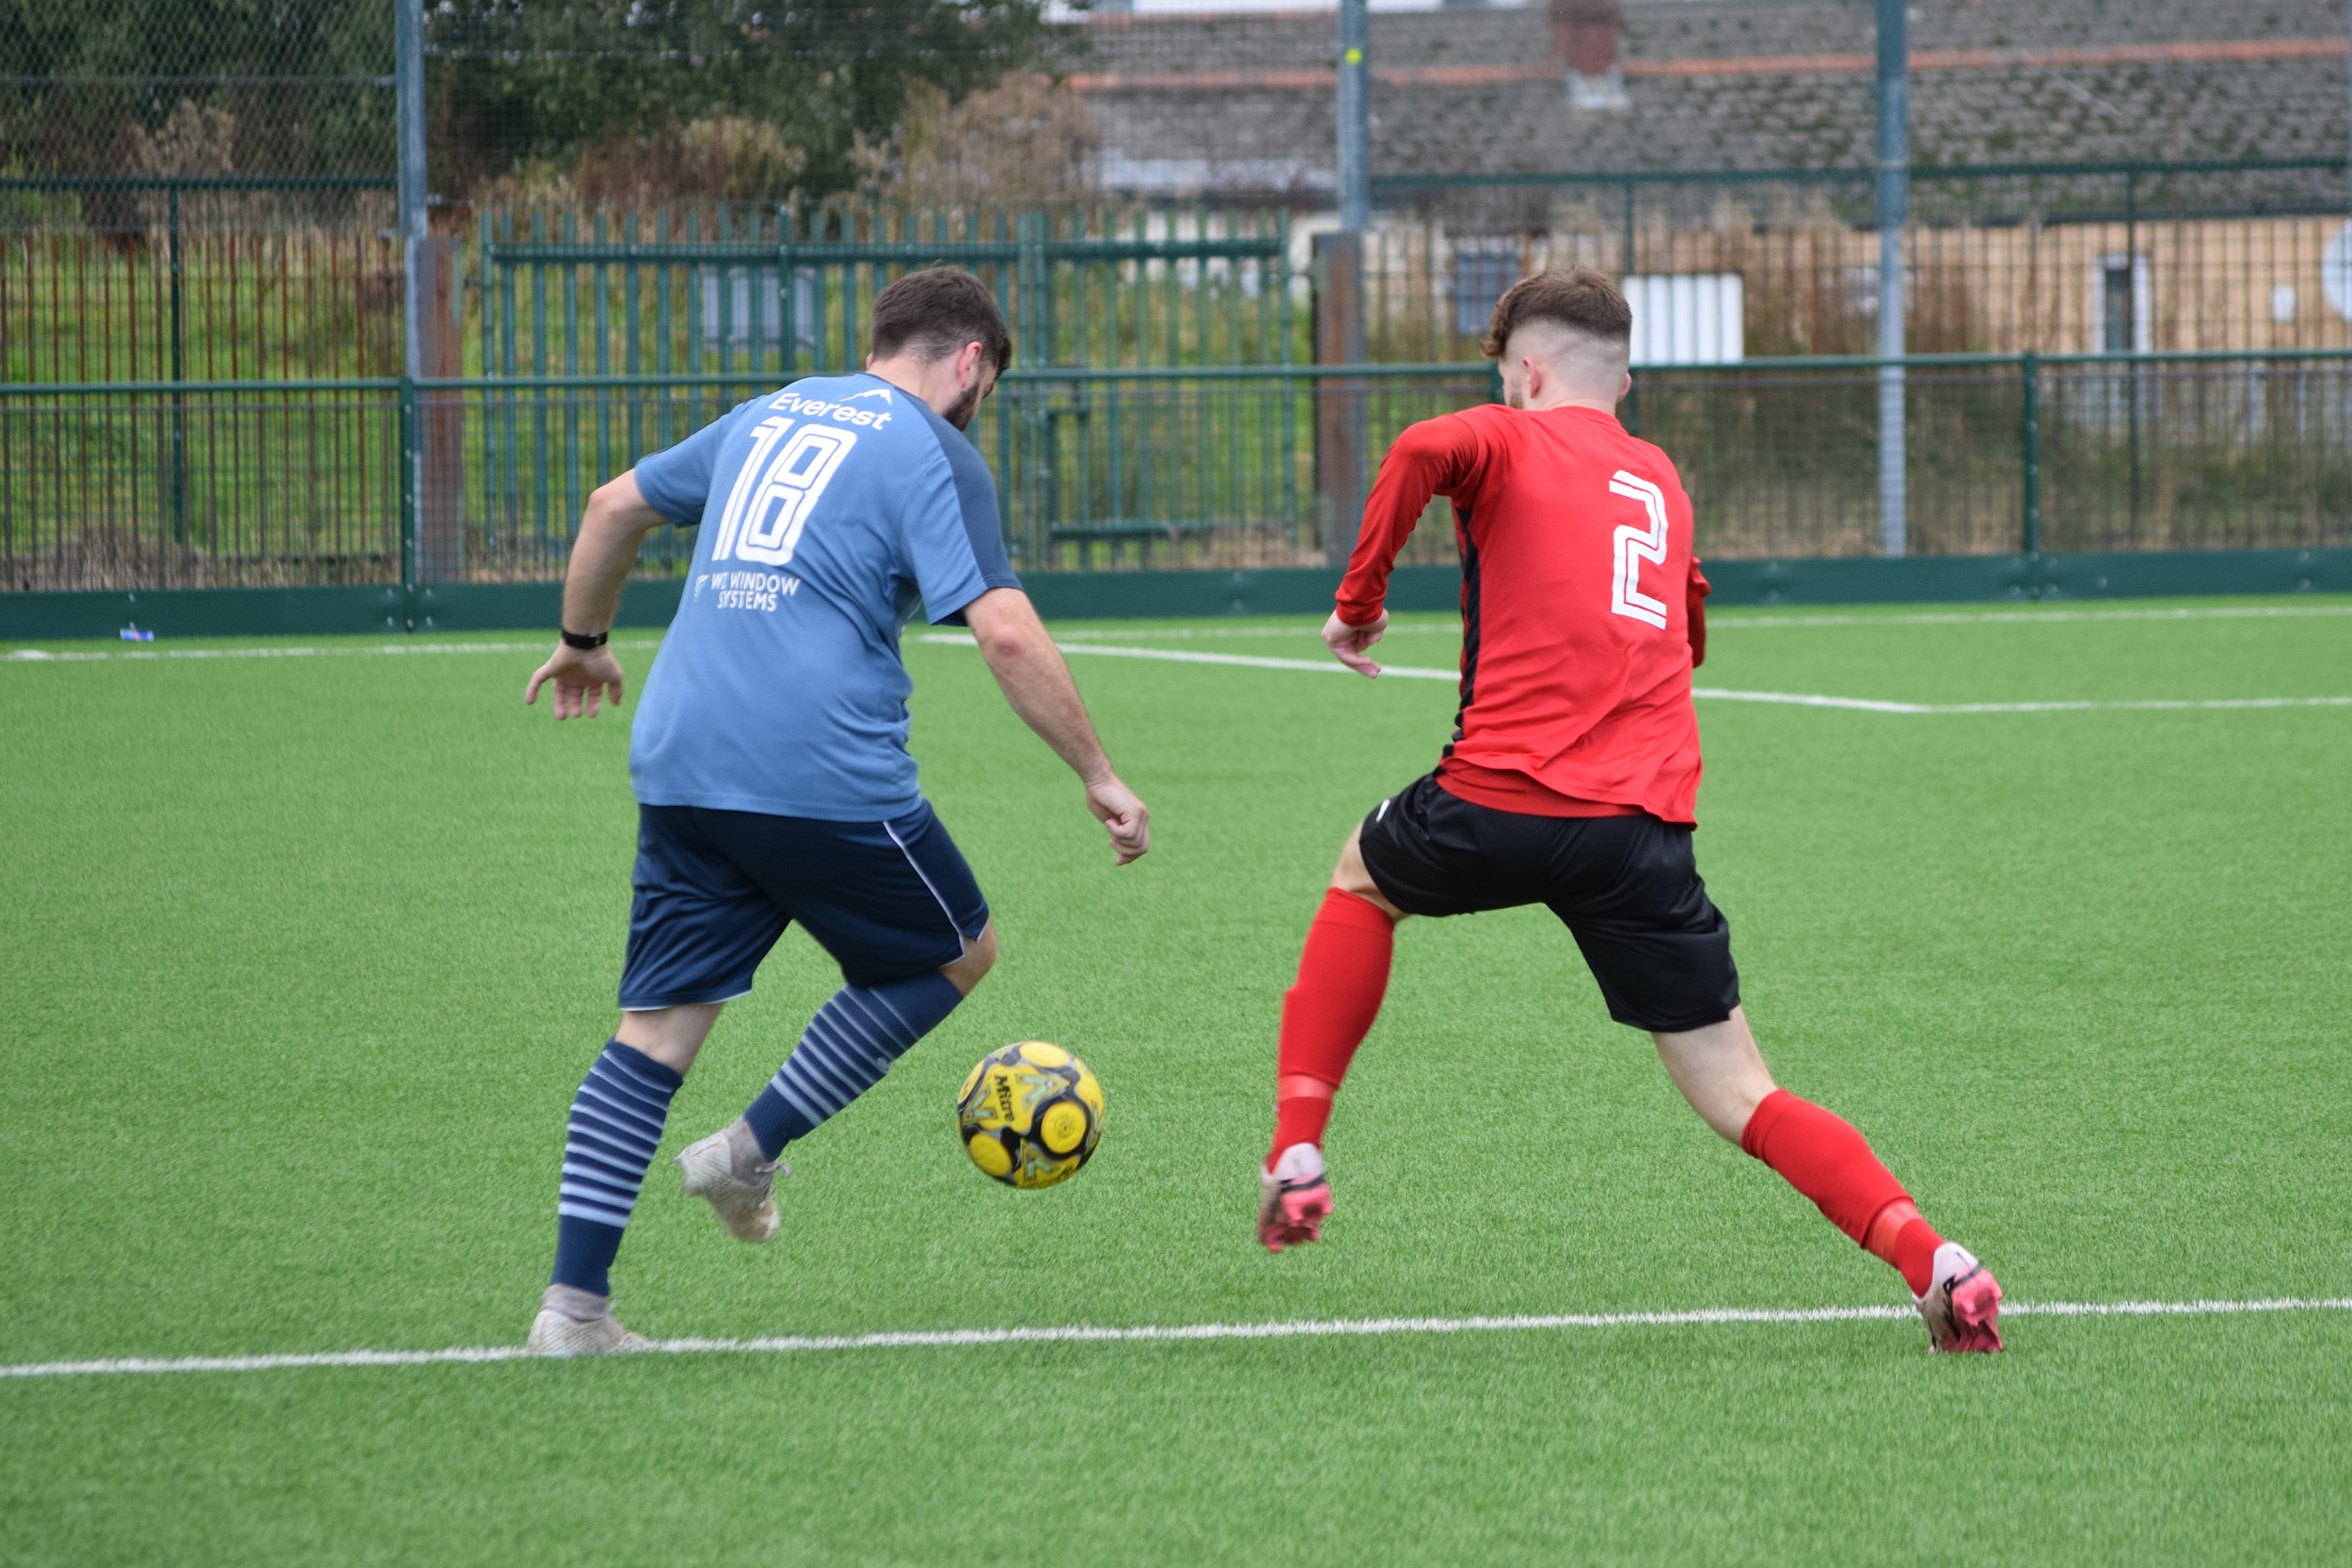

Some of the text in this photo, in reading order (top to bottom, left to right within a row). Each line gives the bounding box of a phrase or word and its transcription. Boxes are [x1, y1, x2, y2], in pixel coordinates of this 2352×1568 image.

[768, 392, 892, 430] Everest
[711, 416, 857, 566] 18
[1609, 469, 1668, 630] 2
[717, 591, 777, 611] SYSTEMS
[730, 571, 801, 596] WINDOW
